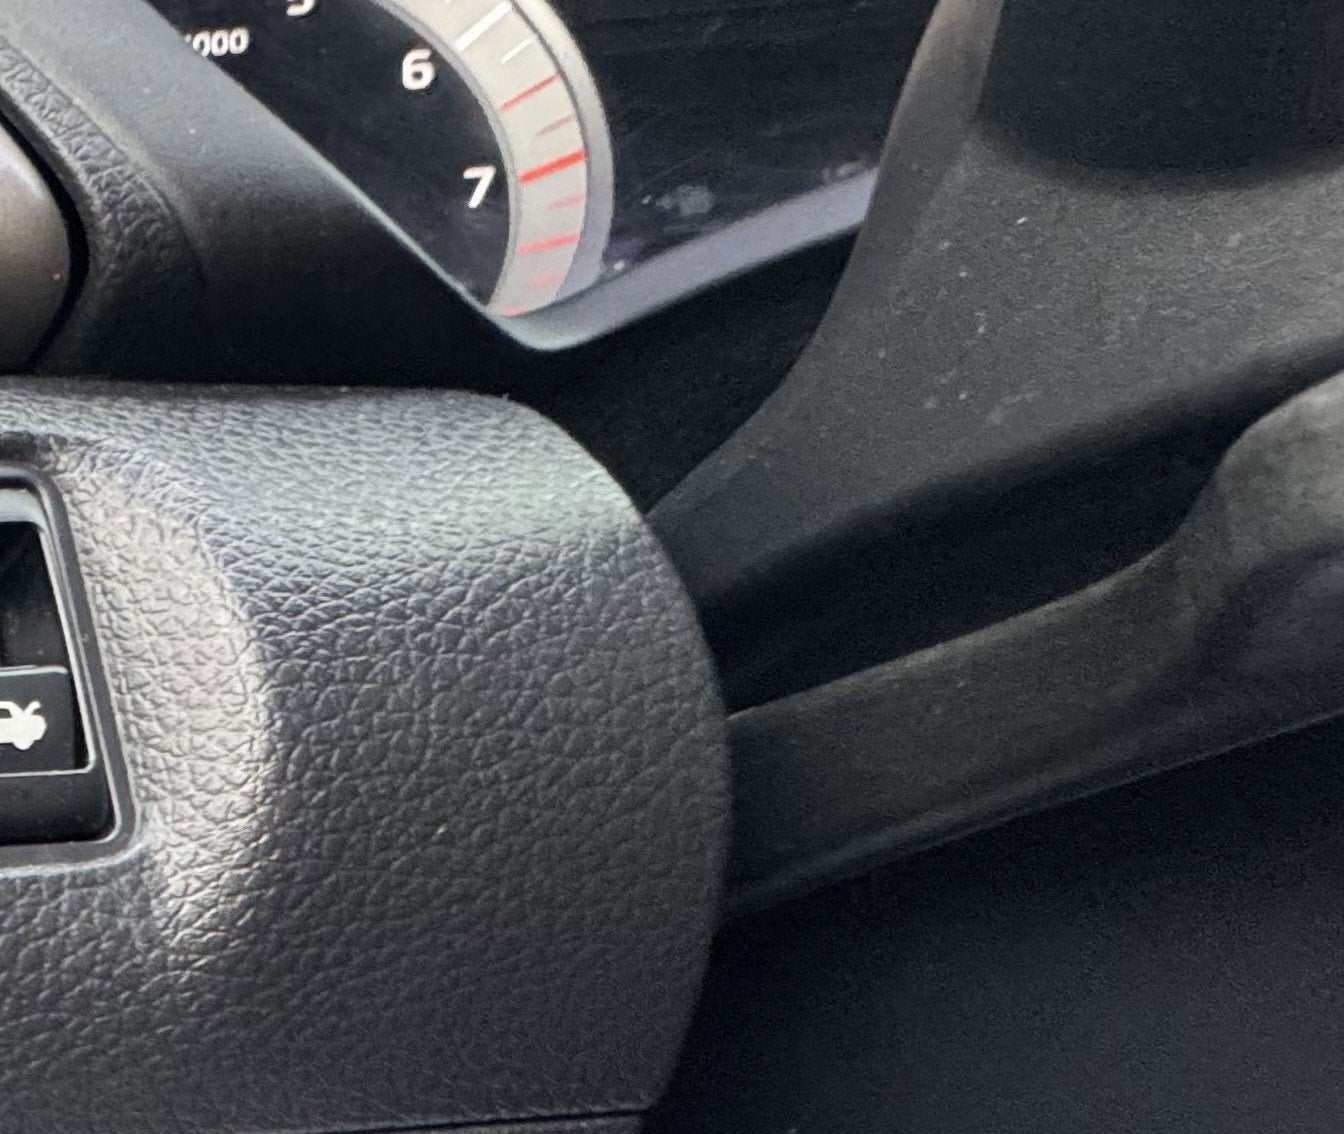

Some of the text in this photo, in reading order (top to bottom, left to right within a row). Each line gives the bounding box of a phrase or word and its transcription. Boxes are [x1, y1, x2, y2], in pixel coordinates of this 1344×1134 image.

[184, 26, 250, 57] 000
[401, 48, 436, 90] 6
[462, 165, 496, 209] 7
